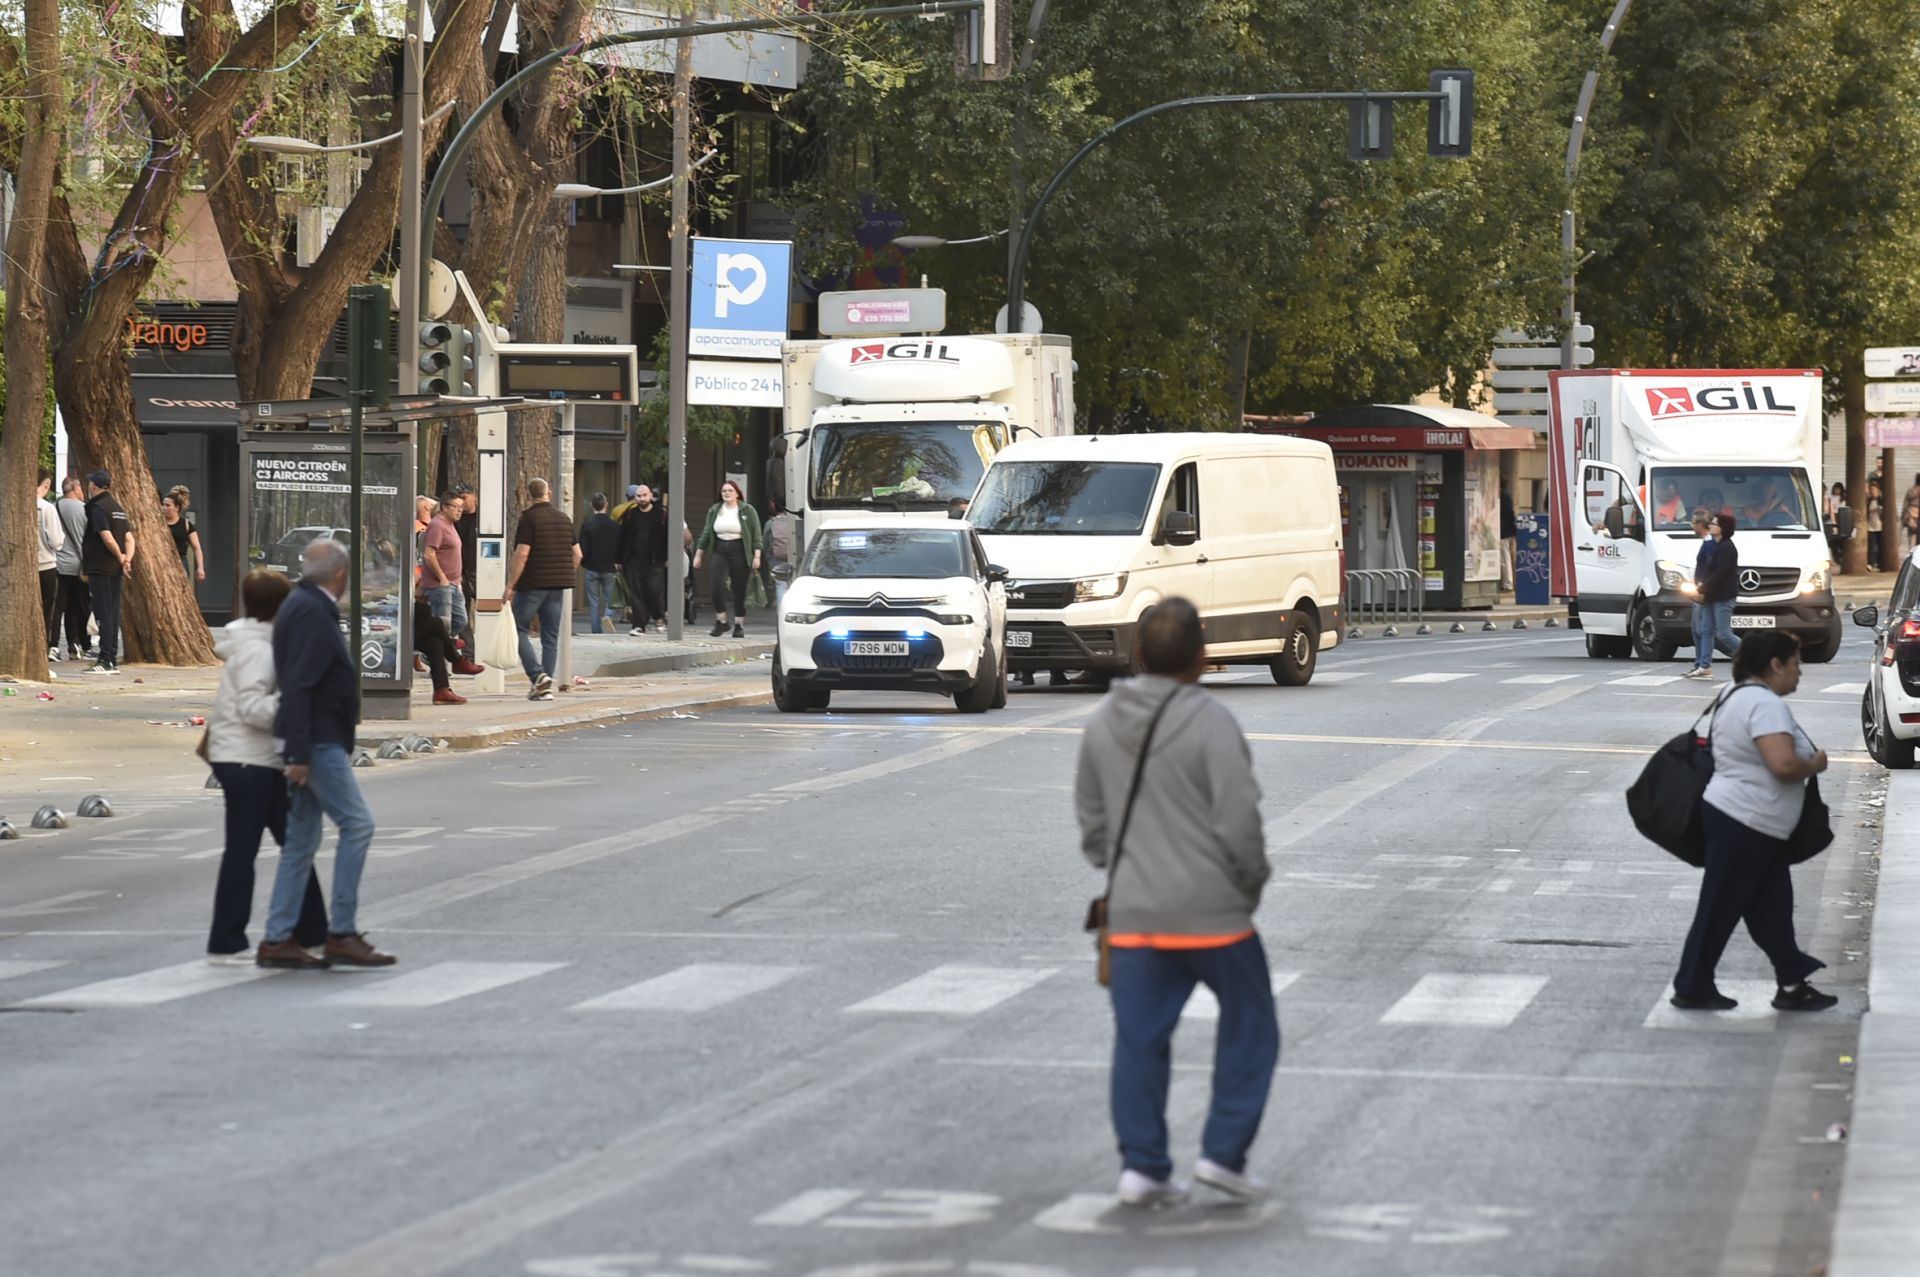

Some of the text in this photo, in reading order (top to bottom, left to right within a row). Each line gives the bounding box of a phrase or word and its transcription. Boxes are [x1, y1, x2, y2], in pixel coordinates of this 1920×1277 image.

[695, 334, 781, 347] aparcamurcia
[694, 376, 782, 392] Público 24 h
[149, 398, 240, 410] Orang
[1370, 435, 1396, 444] Guapo
[1426, 432, 1464, 445] ¡HOLA!
[256, 459, 347, 472] NUEVO CITROËN
[1338, 455, 1409, 468] TOMATON
[256, 470, 329, 482] C3 AIRCROSS
[305, 484, 343, 492] RESISTIRSE
[851, 643, 880, 654] 7696
